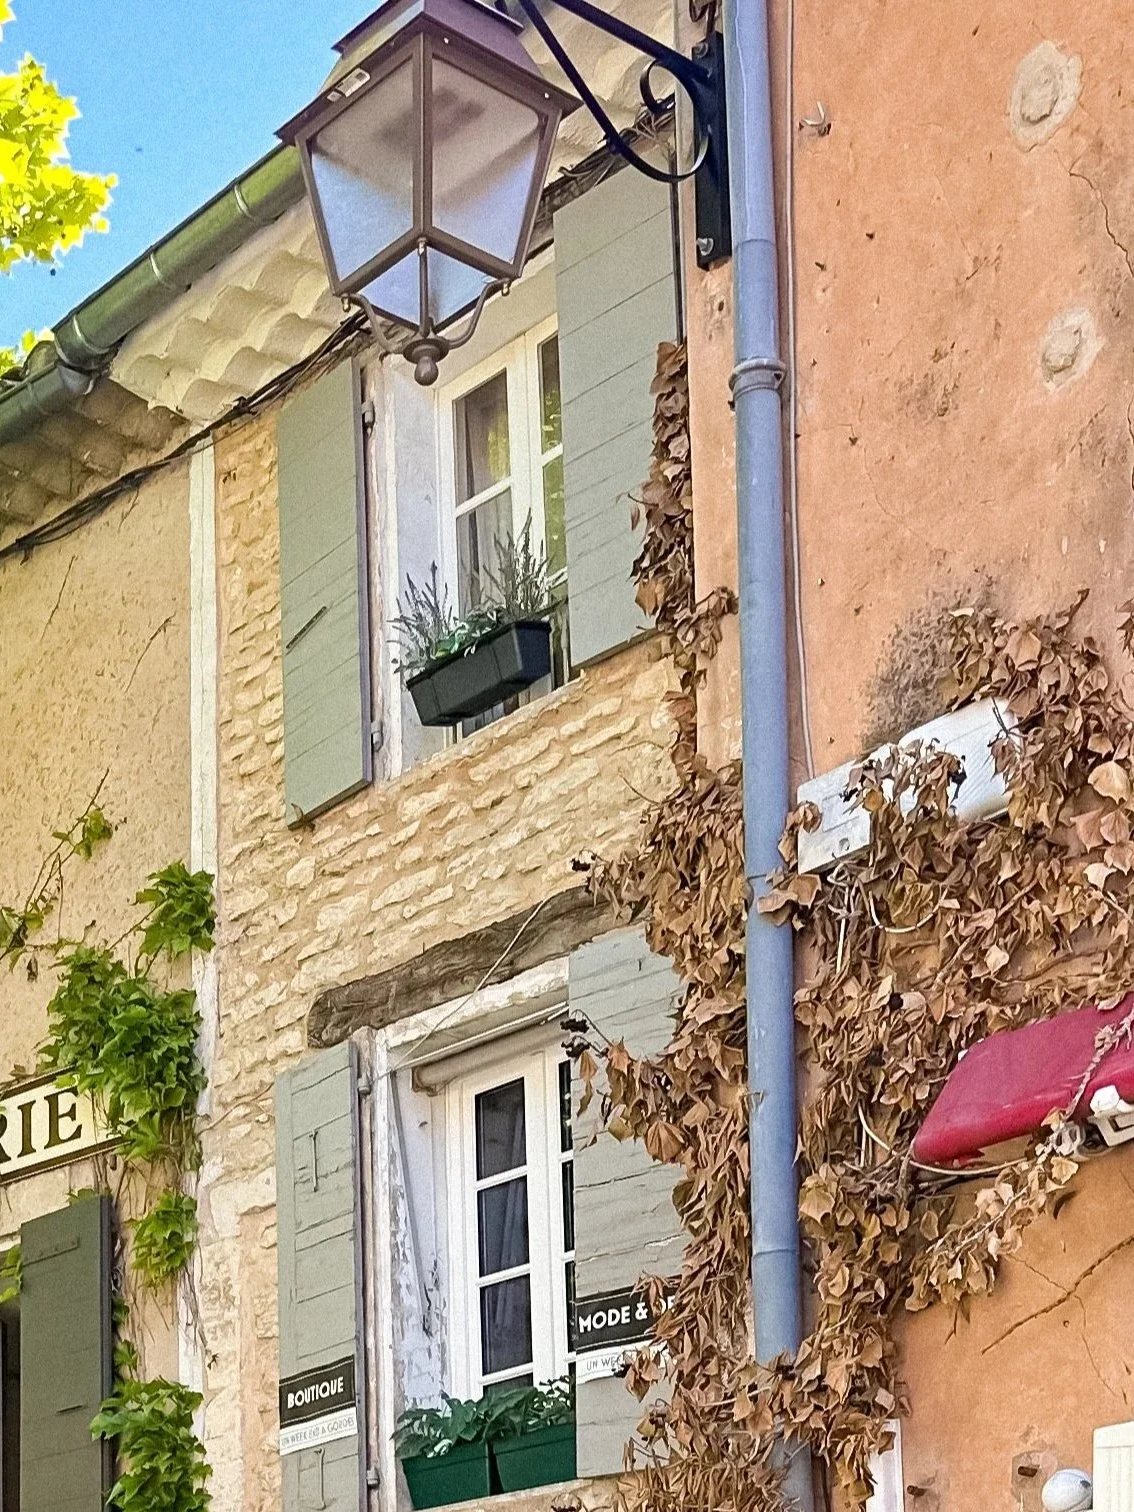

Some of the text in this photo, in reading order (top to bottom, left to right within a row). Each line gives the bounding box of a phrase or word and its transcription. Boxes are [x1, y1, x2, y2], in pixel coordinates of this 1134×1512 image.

[578, 1305, 631, 1334] MODE
[634, 1302, 648, 1320] &
[287, 1376, 344, 1409] BOUTIQUE
